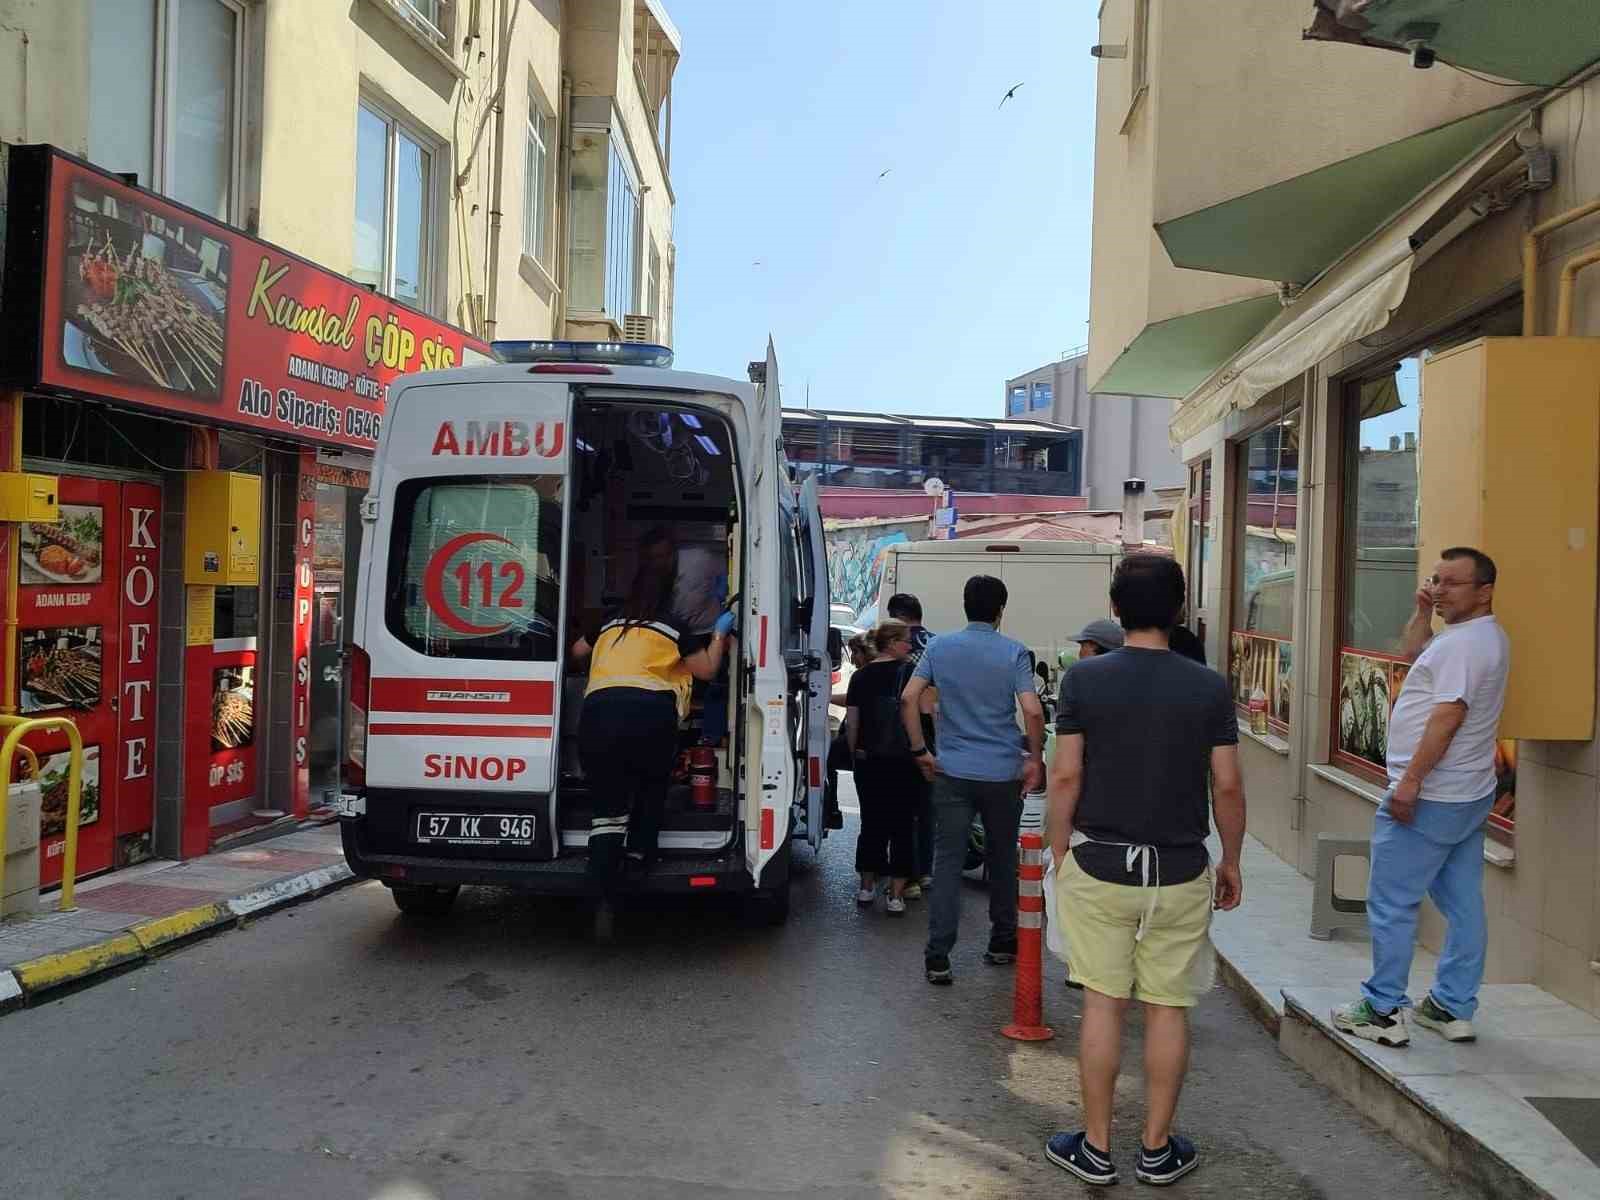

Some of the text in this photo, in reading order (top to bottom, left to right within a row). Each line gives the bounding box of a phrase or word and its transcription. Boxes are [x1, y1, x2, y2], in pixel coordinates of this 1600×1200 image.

[247, 257, 360, 350] Kumsal
[364, 313, 415, 371] ÇÖP
[288, 357, 320, 383] ADANA
[321, 366, 349, 391] KEBAP
[355, 375, 379, 398] KÖFTE
[240, 380, 380, 440] Alo Sipariş: 0546
[432, 421, 564, 457] AMBU
[35, 592, 91, 607] ADANA KEBAP
[455, 562, 525, 608] 112
[124, 508, 156, 780] KÖFTE
[429, 691, 507, 700] TRANSIT
[209, 763, 225, 787] ÖP
[429, 817, 531, 838] 57 KK 946
